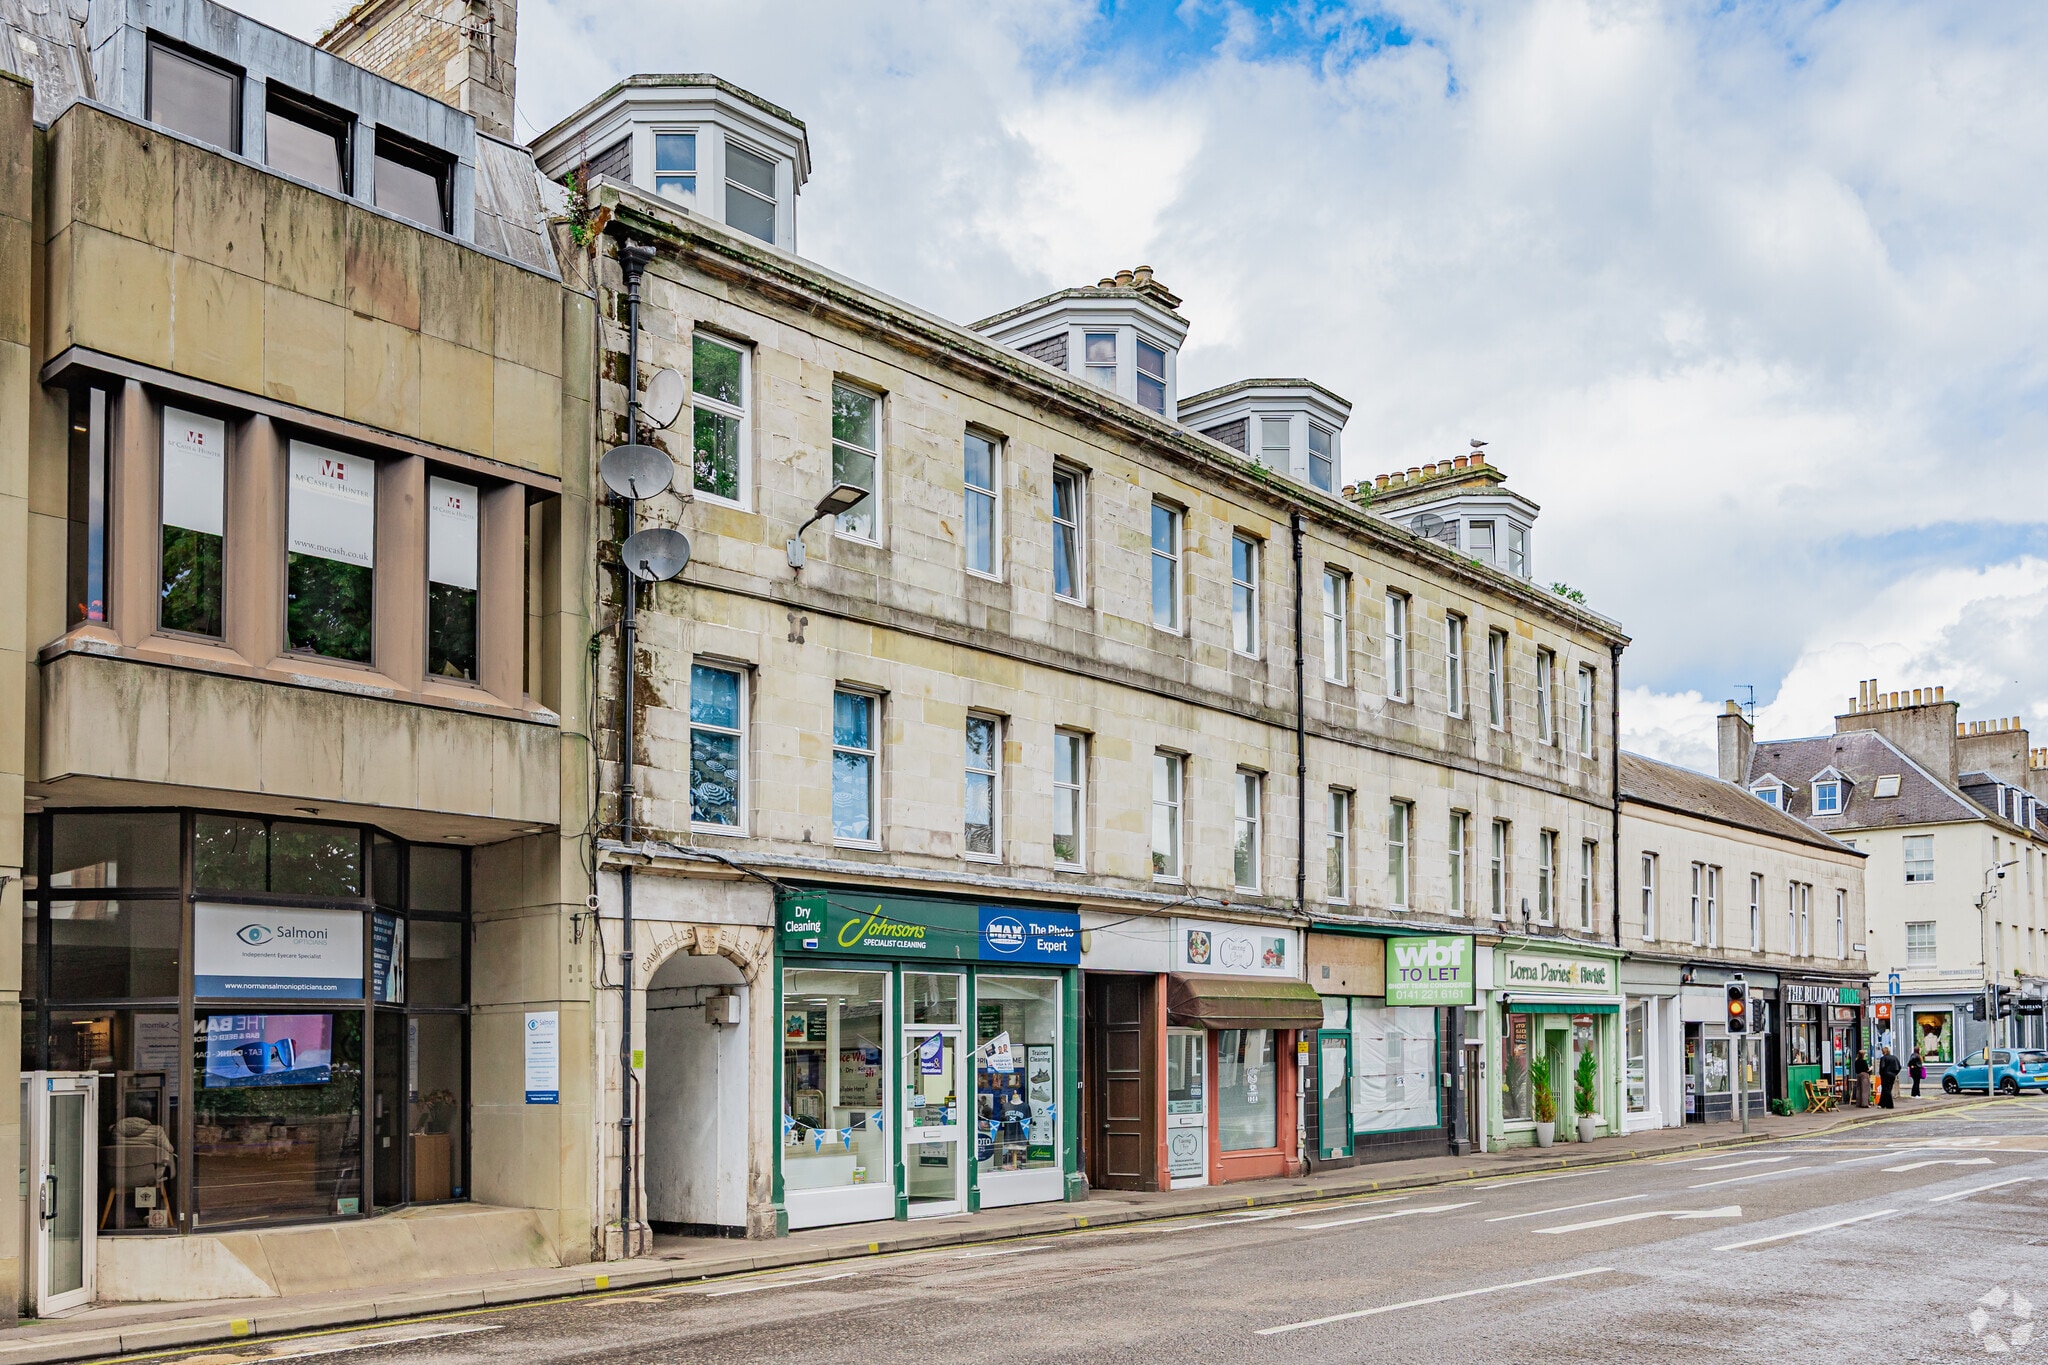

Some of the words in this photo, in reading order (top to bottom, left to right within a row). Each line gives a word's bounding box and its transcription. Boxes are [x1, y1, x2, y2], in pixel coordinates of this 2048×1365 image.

[338, 483, 369, 497] HUNTER
[294, 540, 369, 560] www.mccash.co.uk
[795, 906, 811, 919] Dry
[277, 926, 328, 939] Salmoni
[785, 921, 821, 933] Cleaning
[838, 904, 926, 947] Johnsons
[989, 924, 1023, 939] MAX
[1029, 924, 1047, 935] The
[1048, 925, 1074, 937] Photo
[864, 939, 896, 948] SPECIALIST
[897, 940, 927, 949] CLEANING
[1037, 939, 1067, 953] Expert
[1394, 939, 1465, 967] wbf
[1399, 968, 1422, 981] TO
[1429, 967, 1460, 981] LET
[1510, 960, 1538, 980] Lorna
[1541, 962, 1571, 983] Davies
[225, 982, 337, 991] www.normansalmoniopticians.com
[1396, 991, 1418, 999] 0141
[1421, 990, 1438, 999] 221
[1441, 990, 1464, 998] 6161
[1787, 985, 1803, 1002] THE
[1804, 986, 1839, 1004] BULLDOG
[1840, 987, 1860, 1004] FROG
